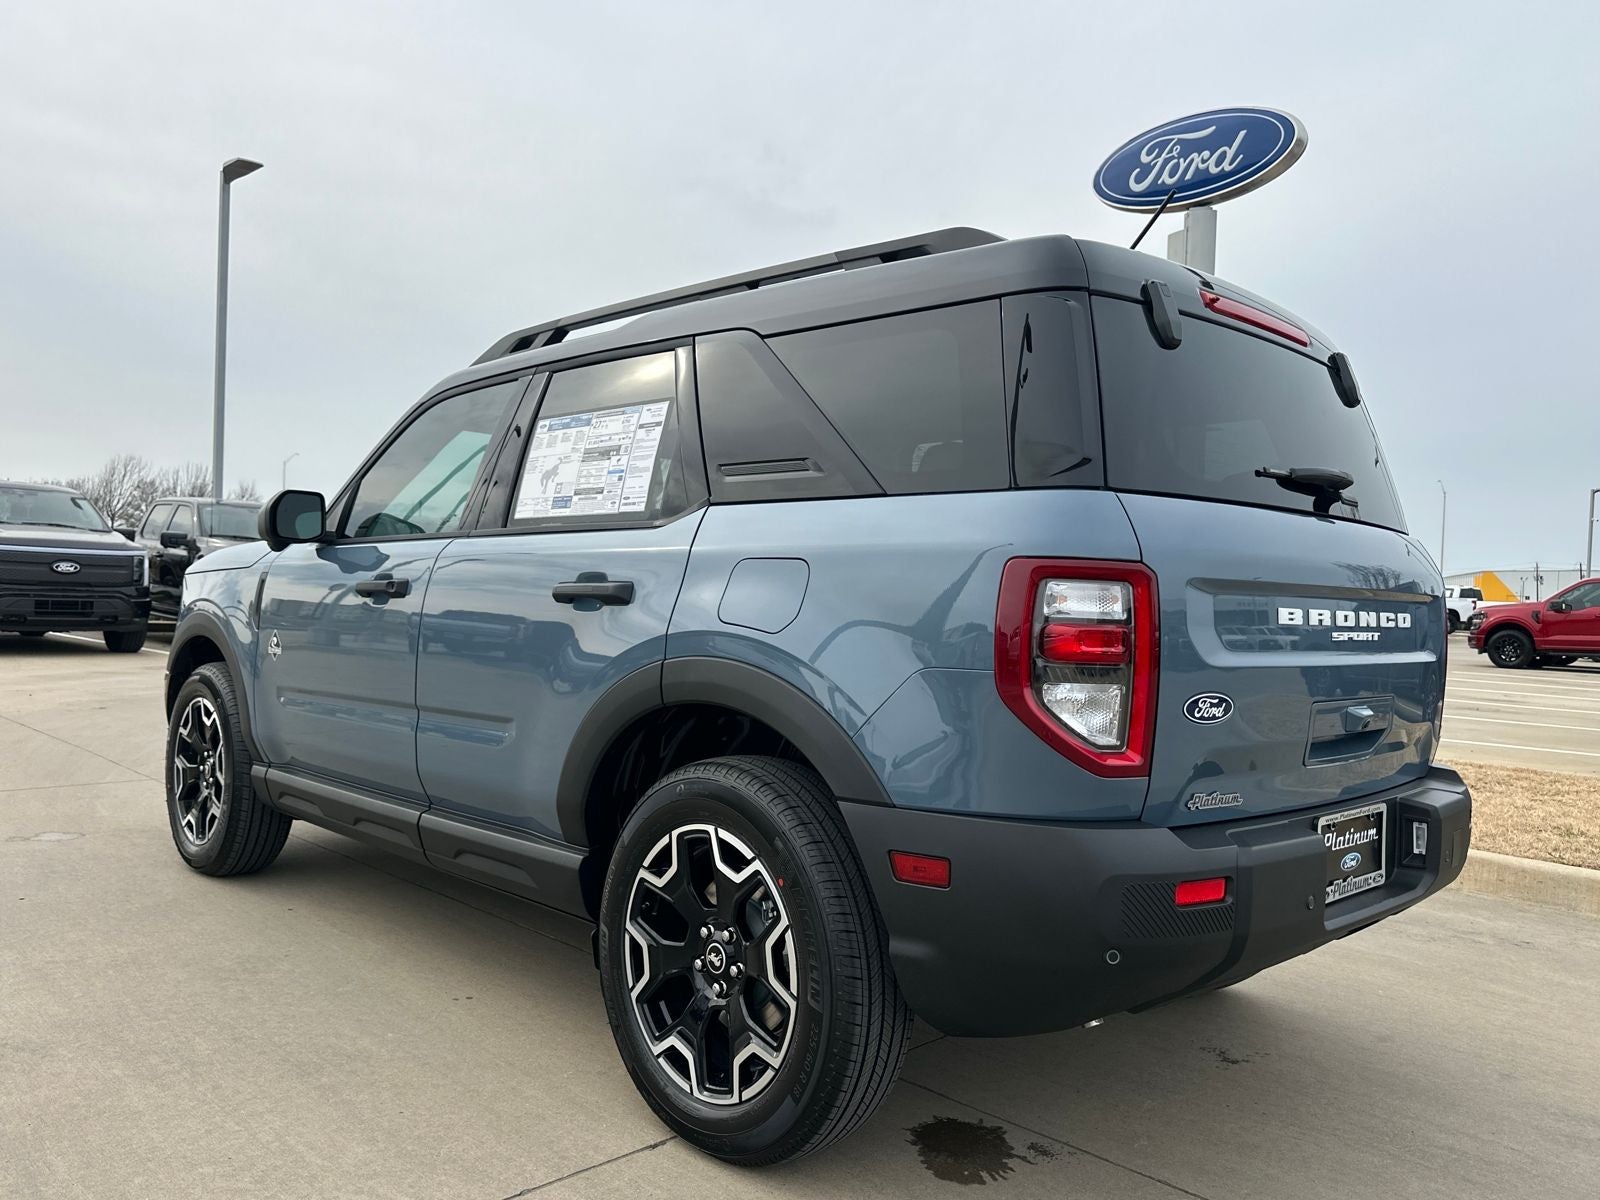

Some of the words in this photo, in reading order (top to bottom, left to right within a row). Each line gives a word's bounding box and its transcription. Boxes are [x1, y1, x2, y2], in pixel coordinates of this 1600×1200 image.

[1128, 125, 1247, 193] Ford
[1277, 607, 1411, 628] BRONCO
[1331, 631, 1381, 641] SPORT
[1194, 697, 1225, 718] Ford
[1187, 791, 1243, 810] Platinum
[1324, 827, 1379, 851] Platinum
[1333, 876, 1372, 898] Platinum
[804, 1023, 819, 1071] 225/60
